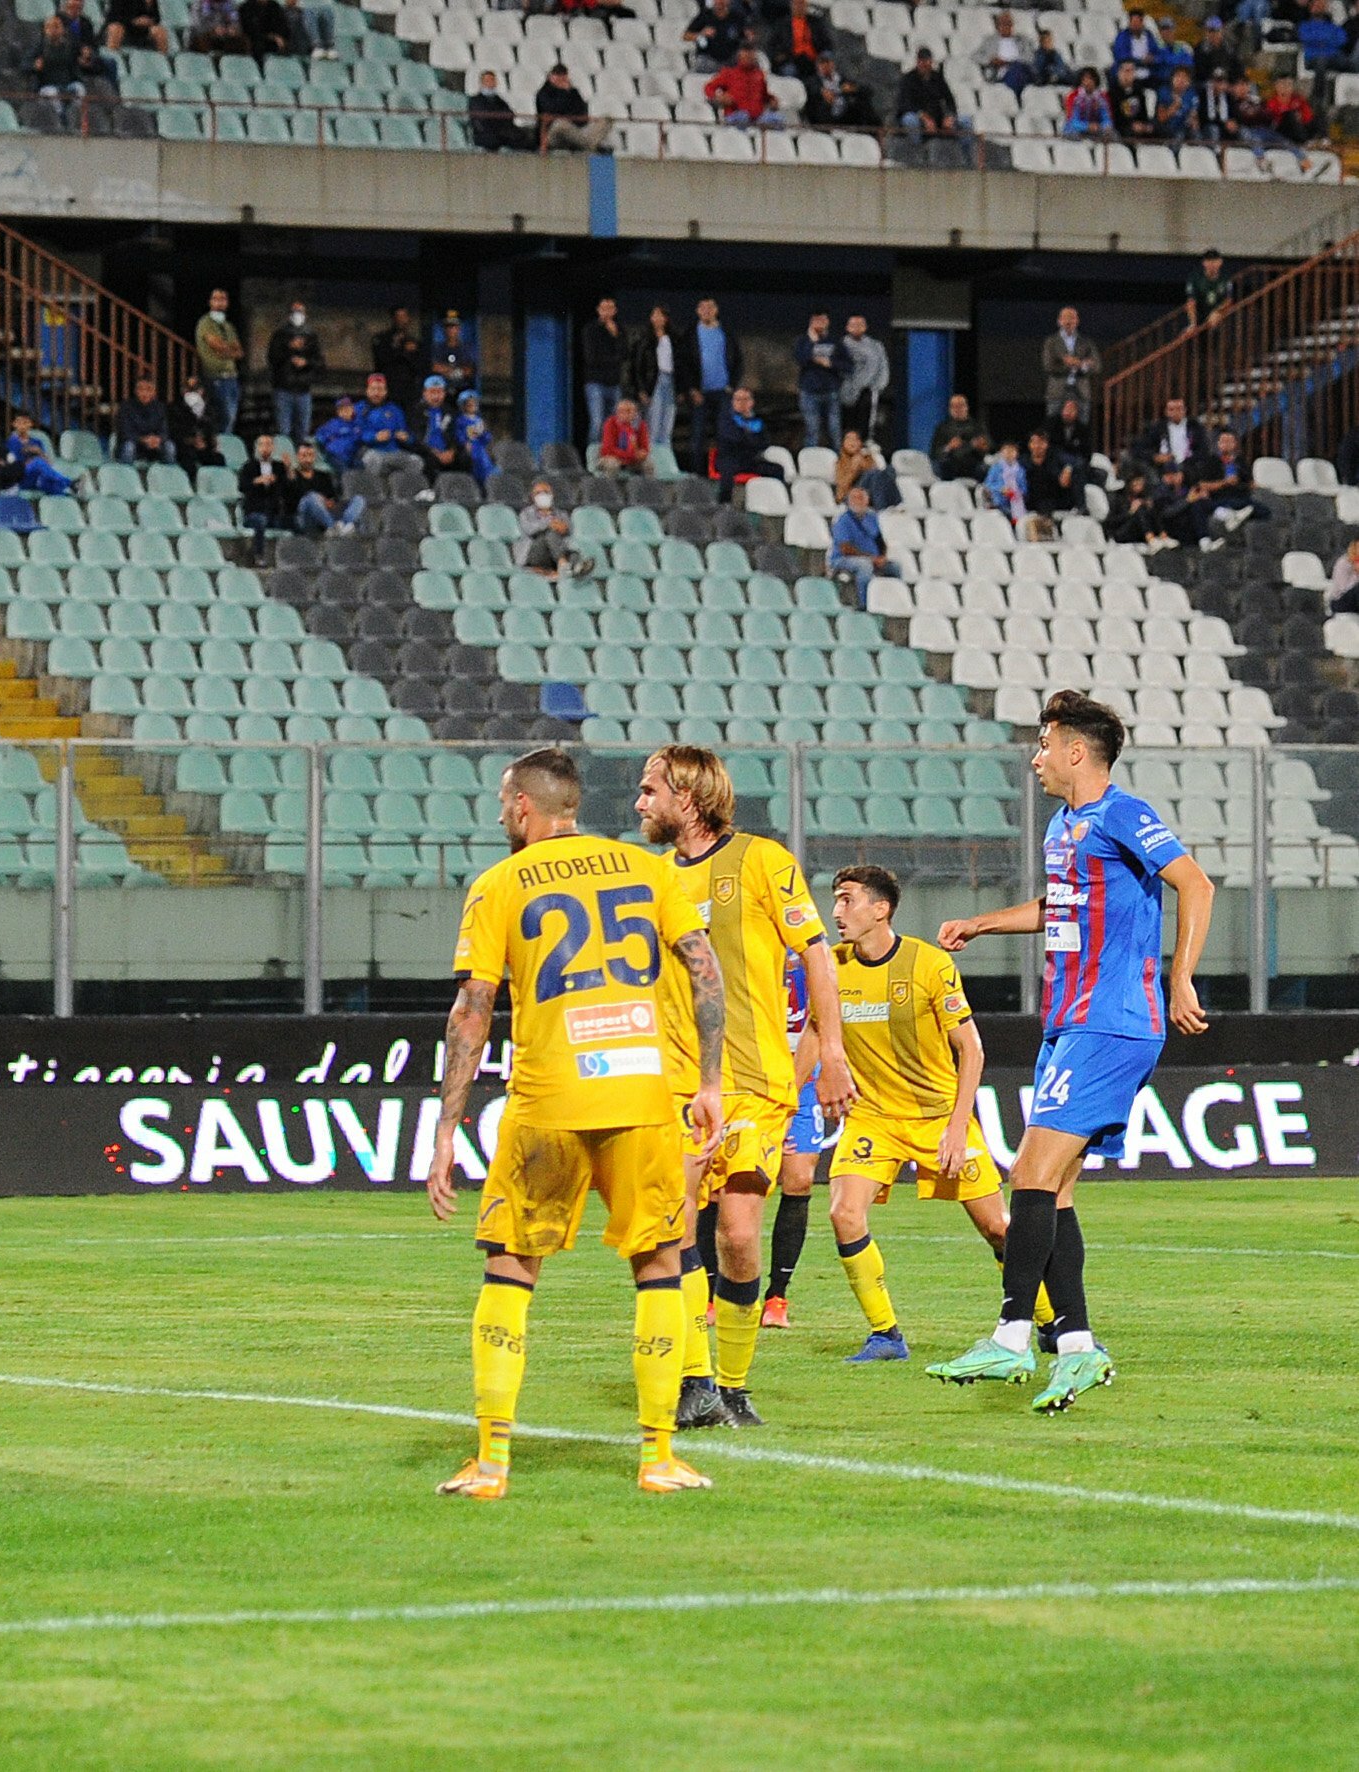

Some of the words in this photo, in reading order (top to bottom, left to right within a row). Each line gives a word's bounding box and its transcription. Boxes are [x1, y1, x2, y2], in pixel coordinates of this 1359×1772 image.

[518, 852, 631, 890] ALTOBELLI
[520, 884, 662, 1004] 25
[1036, 1065, 1071, 1105] 24
[120, 1098, 510, 1184] SAUVA
[852, 1136, 873, 1159] 3
[480, 1333, 524, 1355] 190
